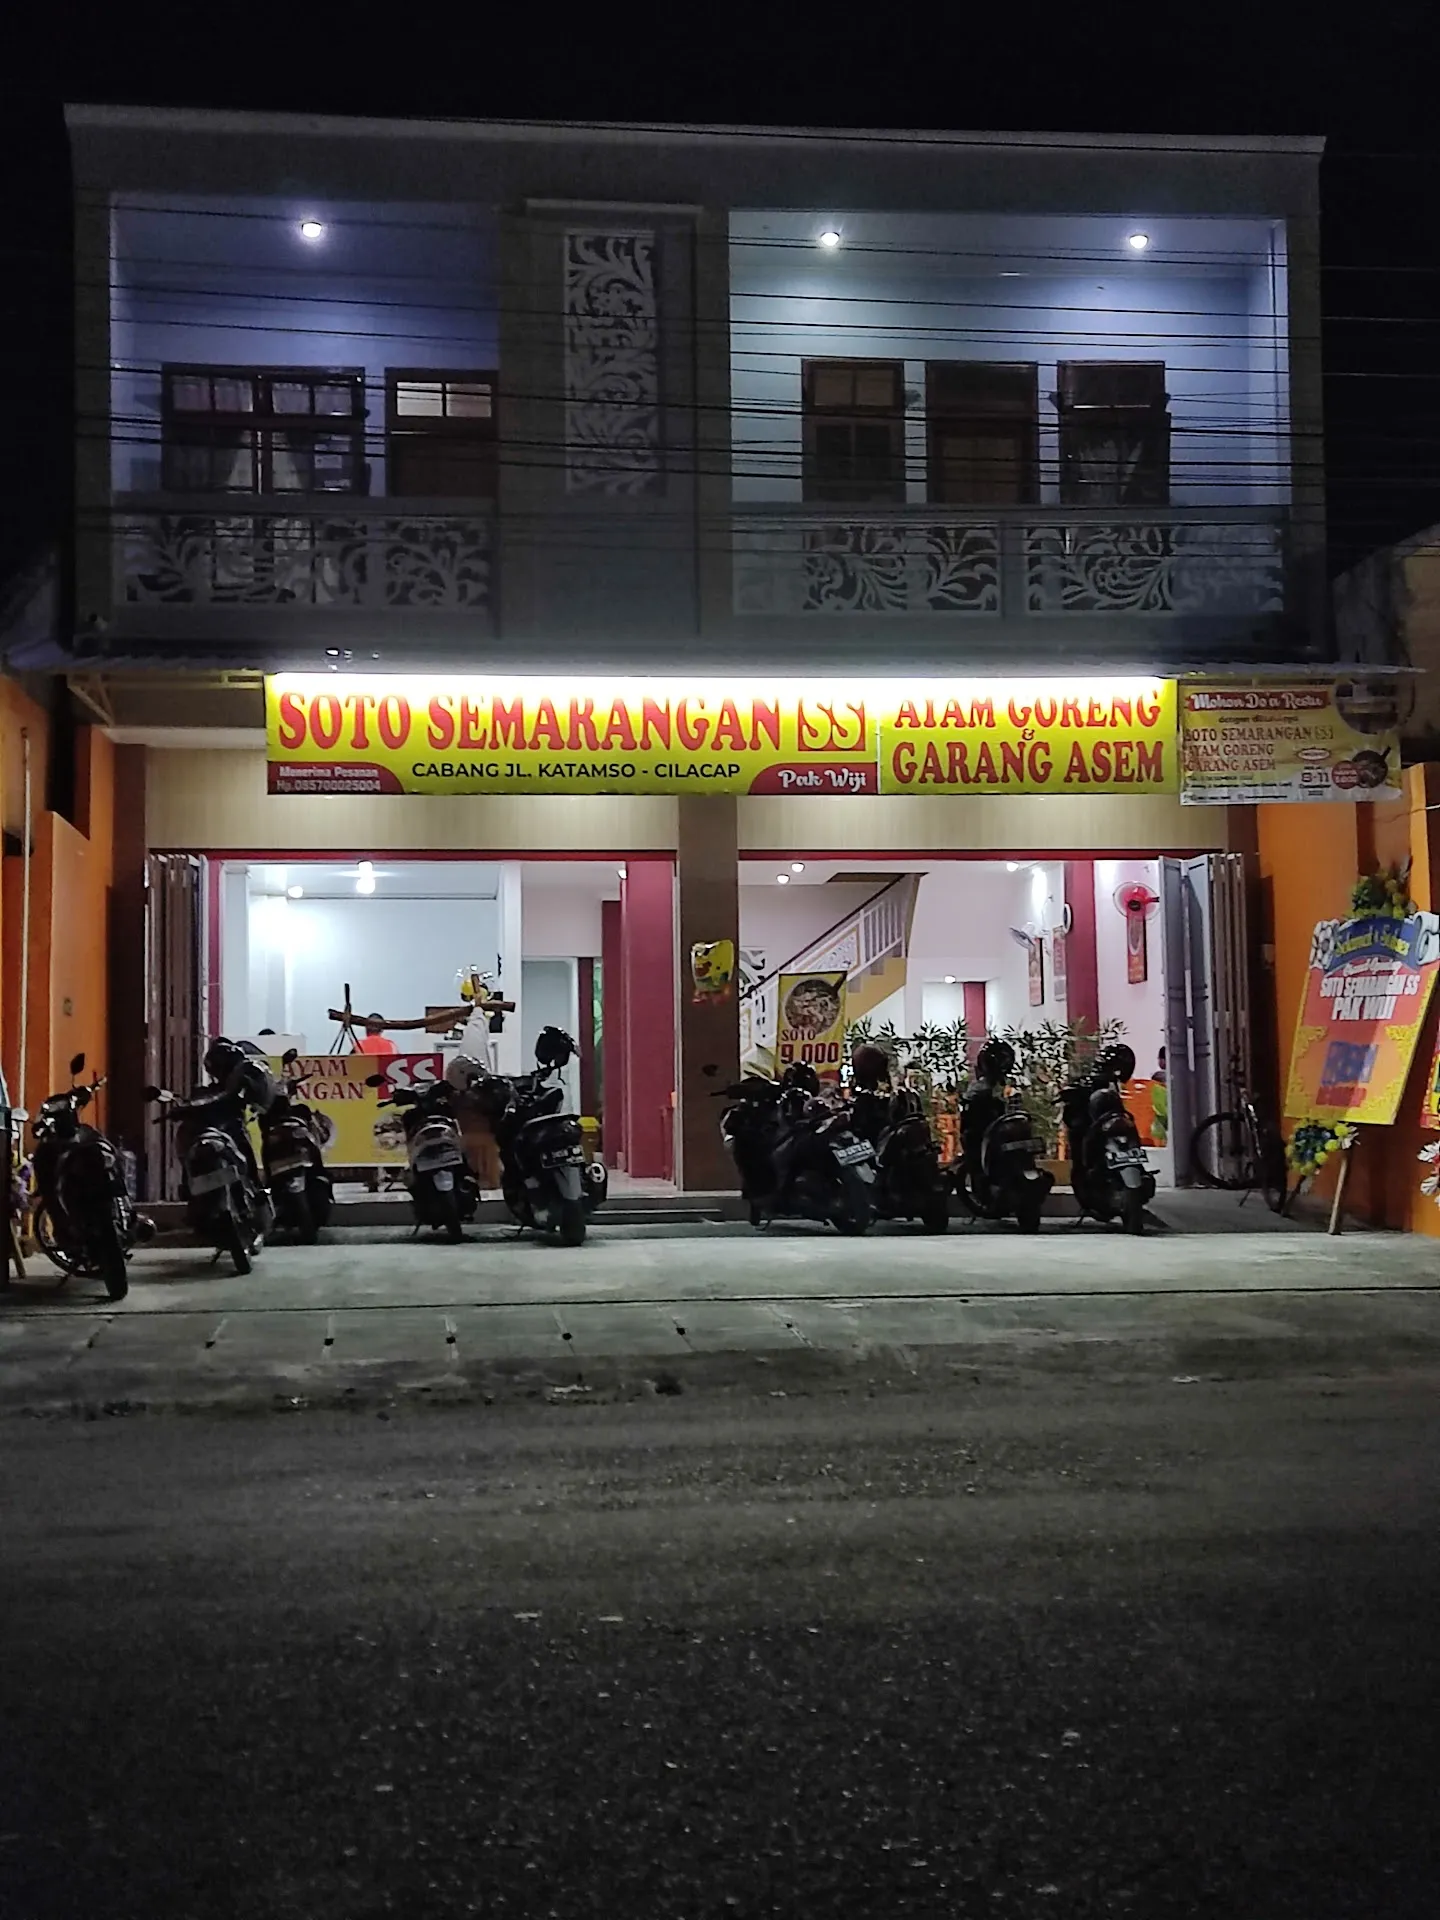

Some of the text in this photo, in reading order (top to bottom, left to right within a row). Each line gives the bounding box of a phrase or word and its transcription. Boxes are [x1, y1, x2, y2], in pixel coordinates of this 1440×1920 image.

[1008, 690, 1161, 728] GORENG
[1190, 693, 1244, 709] Mohon
[1281, 692, 1323, 709] Restu
[279, 692, 864, 751] SOTO SEMARANGAN SS
[1022, 728, 1035, 741] &
[1221, 725, 1312, 741] SEMARANGAN
[1223, 743, 1274, 756] GORENG
[412, 763, 499, 777] CABANG
[505, 763, 532, 777] JL.
[538, 763, 636, 777] KATAMSO
[654, 763, 741, 778] CILACAP
[892, 741, 1164, 784] GARANG ASEM
[279, 766, 379, 777] Menerima Pesanan
[777, 768, 867, 793] Pak Wiji
[781, 1028, 816, 1041] SOTO
[281, 1060, 347, 1077] AYAM
[296, 1082, 364, 1100] NGAN
